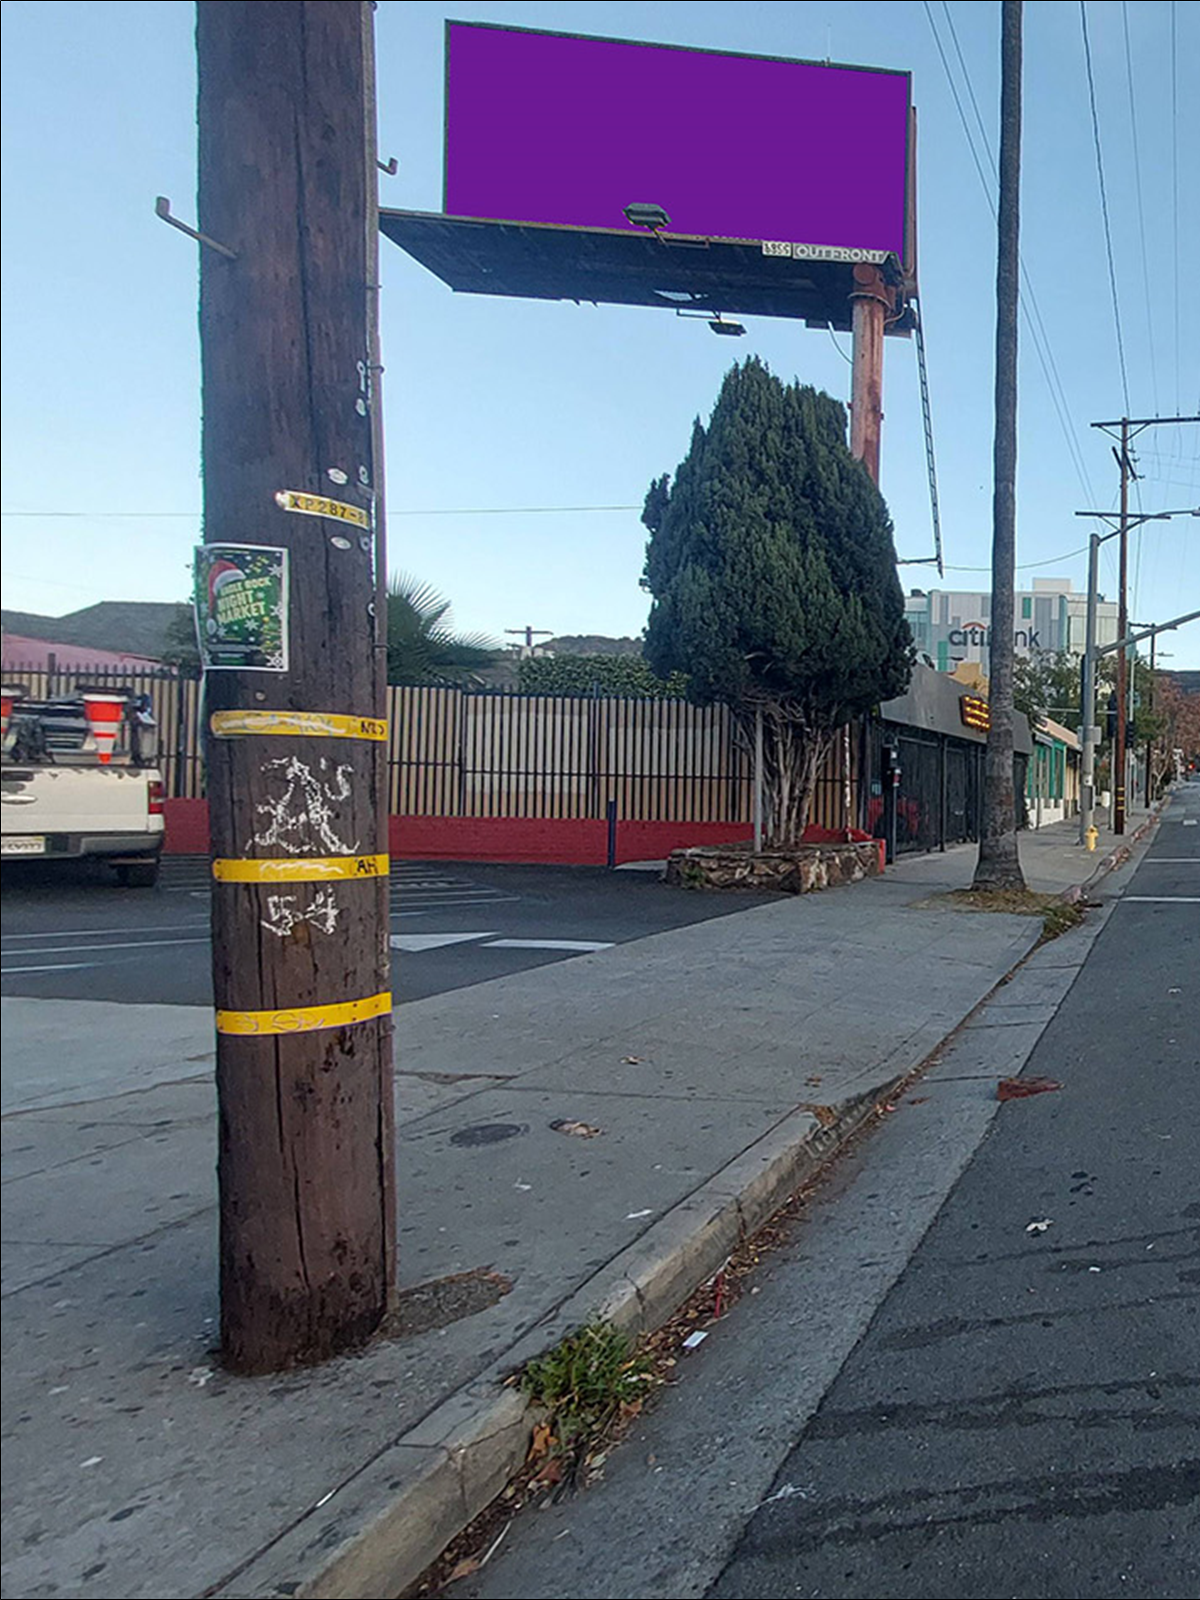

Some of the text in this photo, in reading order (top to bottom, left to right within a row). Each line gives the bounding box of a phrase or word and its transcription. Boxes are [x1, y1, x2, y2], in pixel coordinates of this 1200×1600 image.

[796, 246, 884, 261] OUTFRONT
[217, 590, 254, 610] NIGHT
[216, 602, 261, 625] MARKET
[949, 626, 1040, 647] citink
